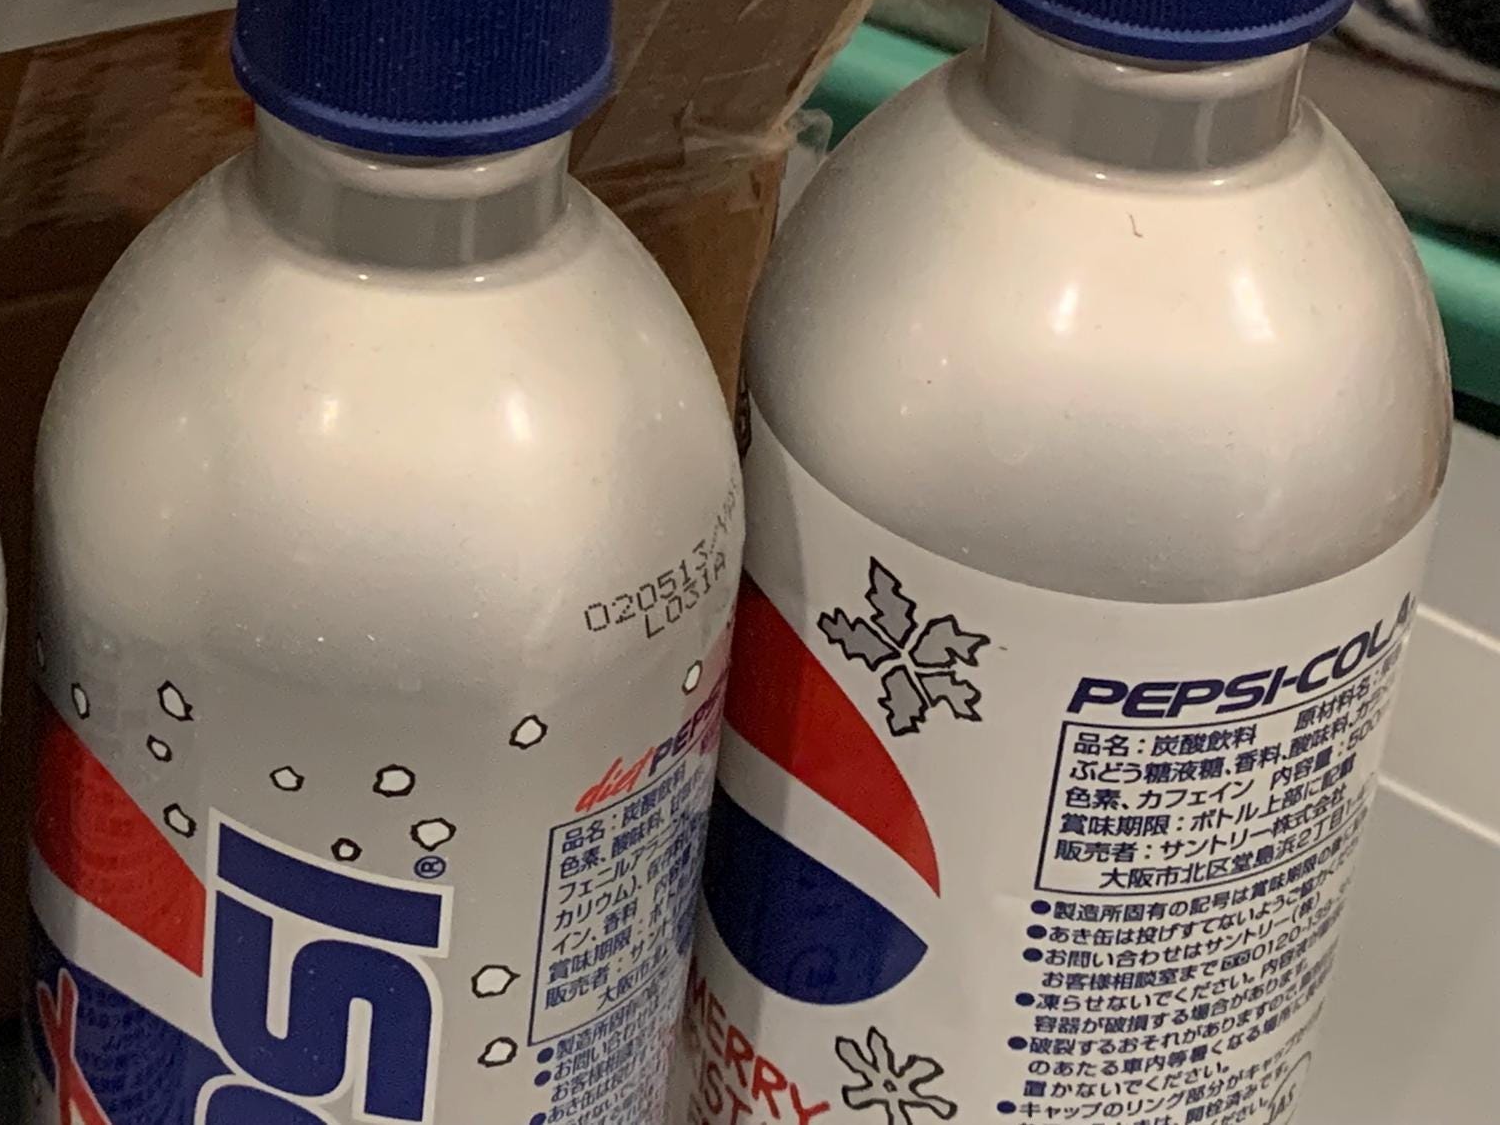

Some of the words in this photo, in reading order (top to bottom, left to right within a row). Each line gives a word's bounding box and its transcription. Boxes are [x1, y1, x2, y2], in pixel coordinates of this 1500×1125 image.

[1065, 779, 1255, 811] 色素、カフェイン
